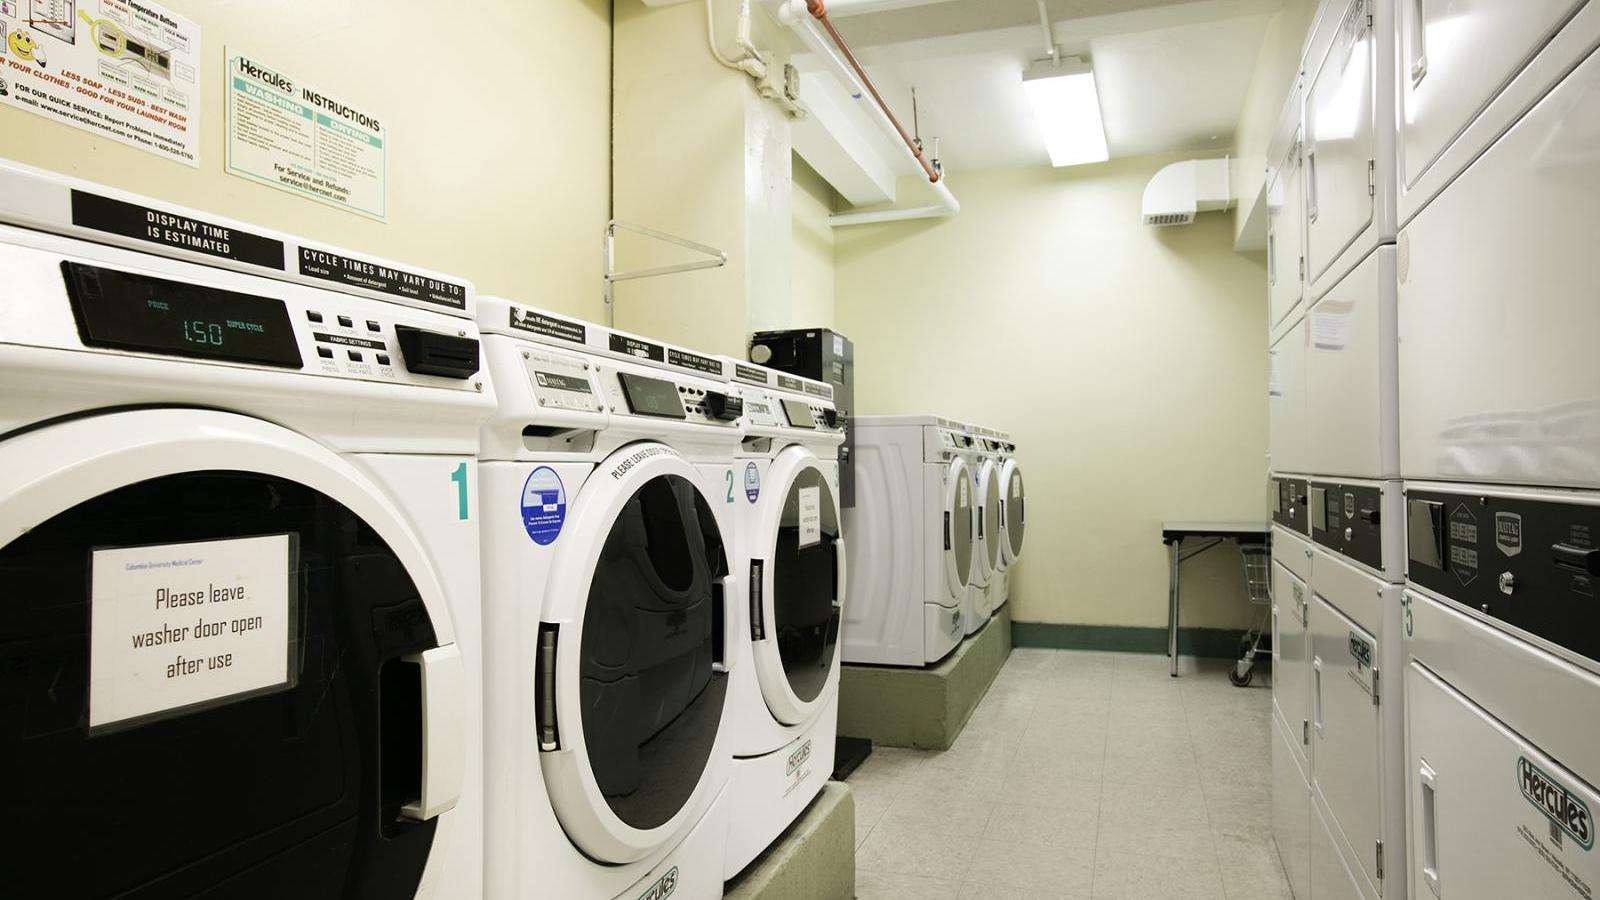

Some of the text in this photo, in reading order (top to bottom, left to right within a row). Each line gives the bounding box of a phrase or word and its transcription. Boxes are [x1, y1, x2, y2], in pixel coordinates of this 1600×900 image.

[160, 14, 178, 28] Buttons
[8, 60, 32, 74] YOUR
[33, 70, 70, 88] CLOTHES
[76, 86, 98, 98] GOOD
[100, 96, 115, 105] FOR
[116, 100, 136, 112] YOUR
[136, 108, 168, 124] LAUNDRY
[168, 122, 187, 132] ROOM
[14, 94, 39, 107] e-mail:
[61, 69, 186, 122] LESS SOAP LESS SUDS BEST WASH
[240, 57, 292, 93] Hercules
[302, 88, 380, 132] INSTRUCTIONS
[245, 84, 304, 115] WASHING
[15, 82, 30, 94] FOR
[32, 88, 47, 99] OUR
[49, 96, 72, 108] QUICK
[73, 104, 103, 120] SERVICE:
[104, 114, 124, 126] Report
[126, 122, 152, 136] Problems
[153, 132, 186, 150] Immediately
[330, 120, 370, 143] DRYING
[274, 163, 285, 172] For
[286, 168, 310, 182] Service
[312, 178, 324, 186] and
[325, 180, 351, 195] Refunds:
[280, 176, 347, 202] service@hercnet.com
[146, 211, 230, 242] DISPLAY TIME
[147, 226, 230, 254] IS ESTIMATED
[304, 250, 462, 296] CYCLE TIMES MAY VARY DUE TO:
[308, 266, 319, 274] Load
[184, 320, 222, 345] 1.50
[226, 320, 264, 332] SUPER CYCLE
[330, 336, 372, 347] FABRIC SETTINGS
[626, 340, 640, 348] DISPLAY
[669, 350, 681, 359] CYCLE
[681, 353, 692, 362] TIMES
[611, 458, 635, 480] PLEASE
[630, 450, 648, 464] LEAVE
[451, 462, 468, 520] 1
[726, 470, 734, 504] 2
[126, 562, 148, 571] Columbia
[148, 562, 171, 570] University
[156, 583, 244, 610] Please leave
[1406, 596, 1414, 638] 5
[132, 616, 262, 649] washer door open
[167, 652, 233, 678] after use
[1522, 760, 1588, 841] Hercules
